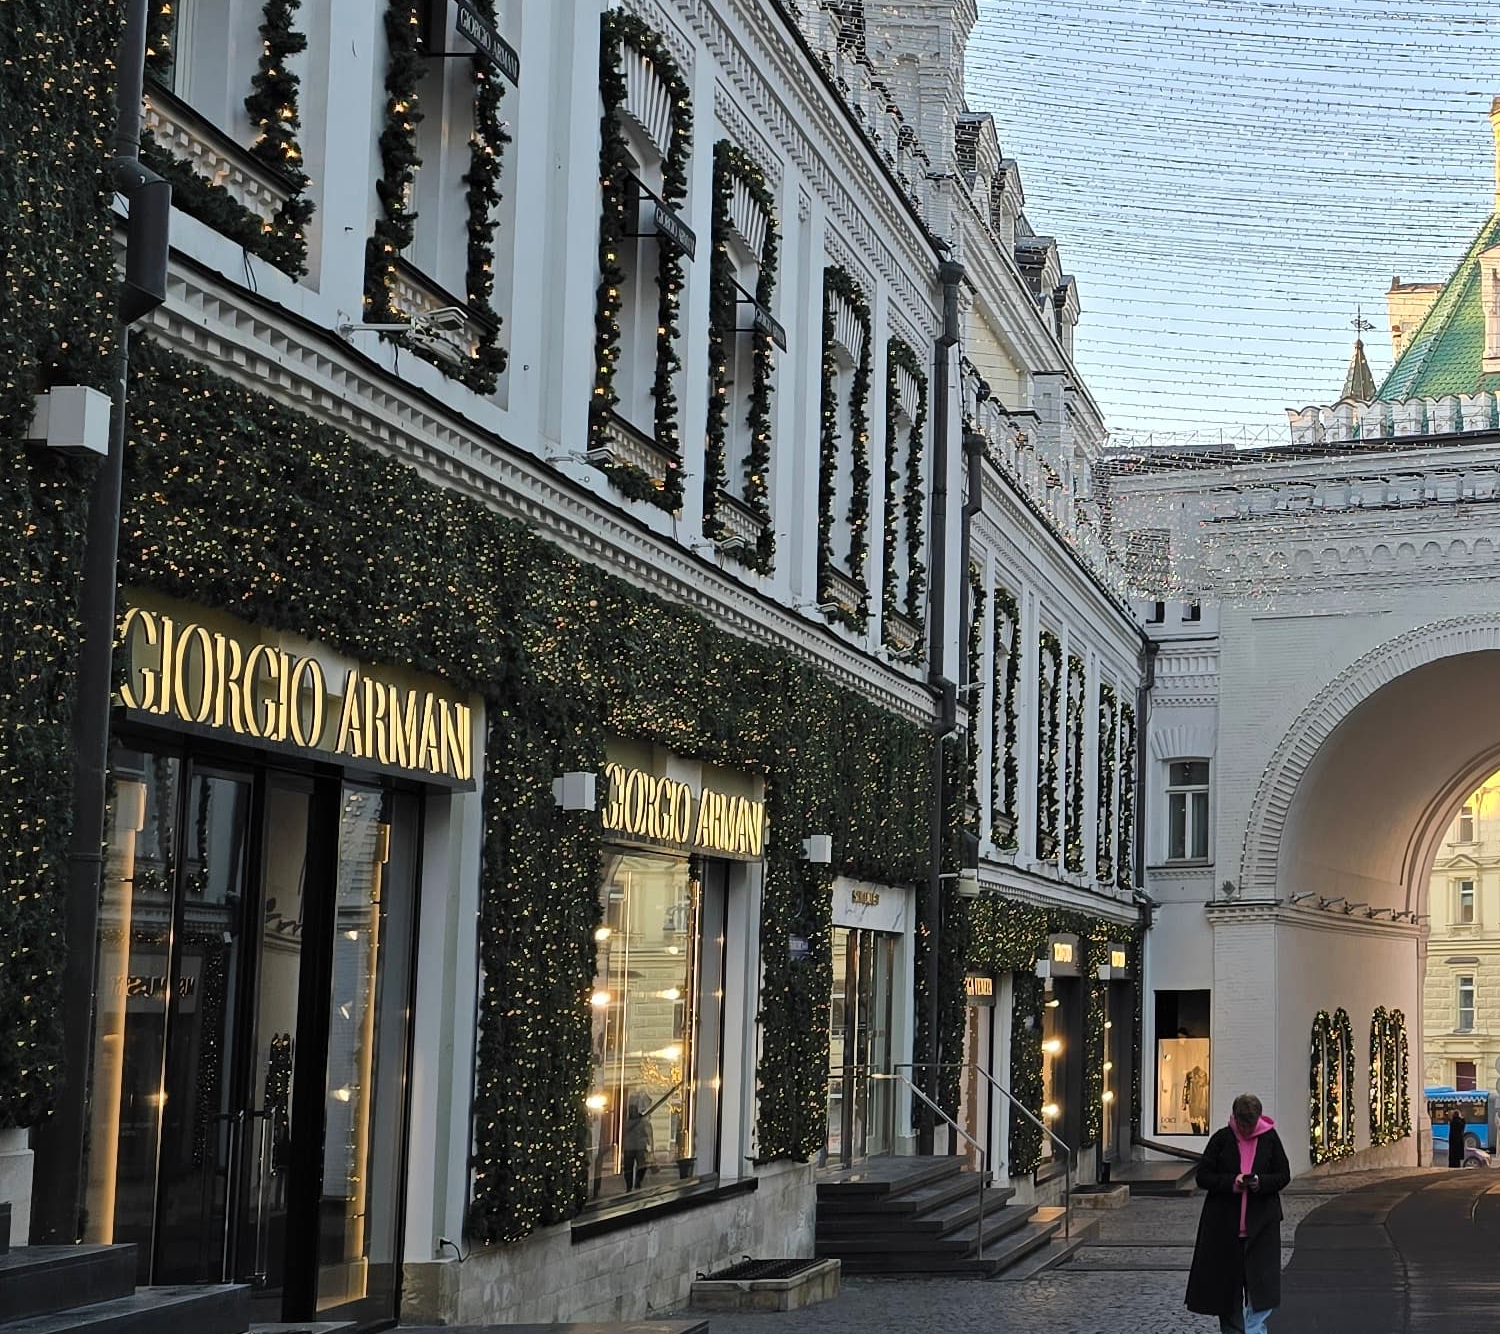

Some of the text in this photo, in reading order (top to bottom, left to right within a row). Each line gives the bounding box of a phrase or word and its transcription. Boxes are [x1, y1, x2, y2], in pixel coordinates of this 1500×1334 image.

[119, 607, 472, 781] GIORGIO ARMANI
[602, 762, 763, 857] GIORGIO ARMANI
